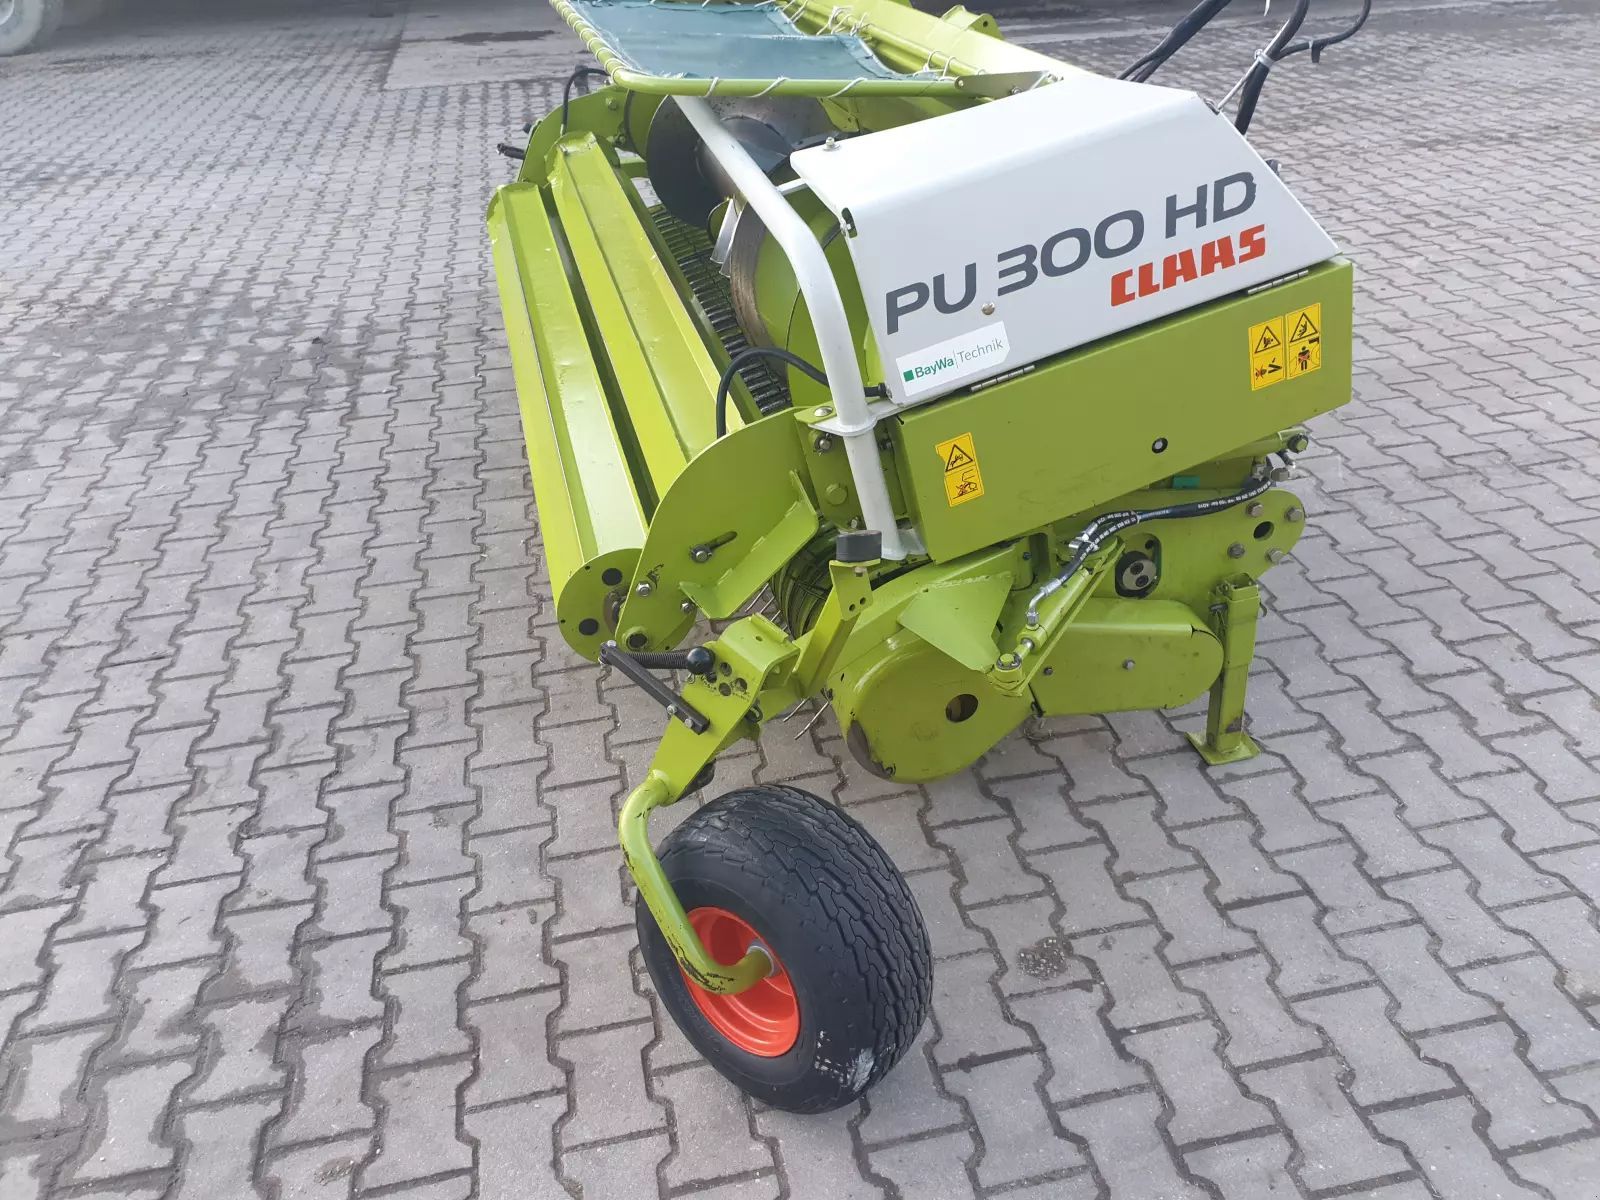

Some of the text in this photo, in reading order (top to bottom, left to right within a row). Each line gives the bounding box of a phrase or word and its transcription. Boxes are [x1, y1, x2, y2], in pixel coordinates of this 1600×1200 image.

[885, 171, 1257, 336] PU 300 HD
[1110, 223, 1266, 307] CLAAS
[914, 337, 1004, 379] BayWa Technik
